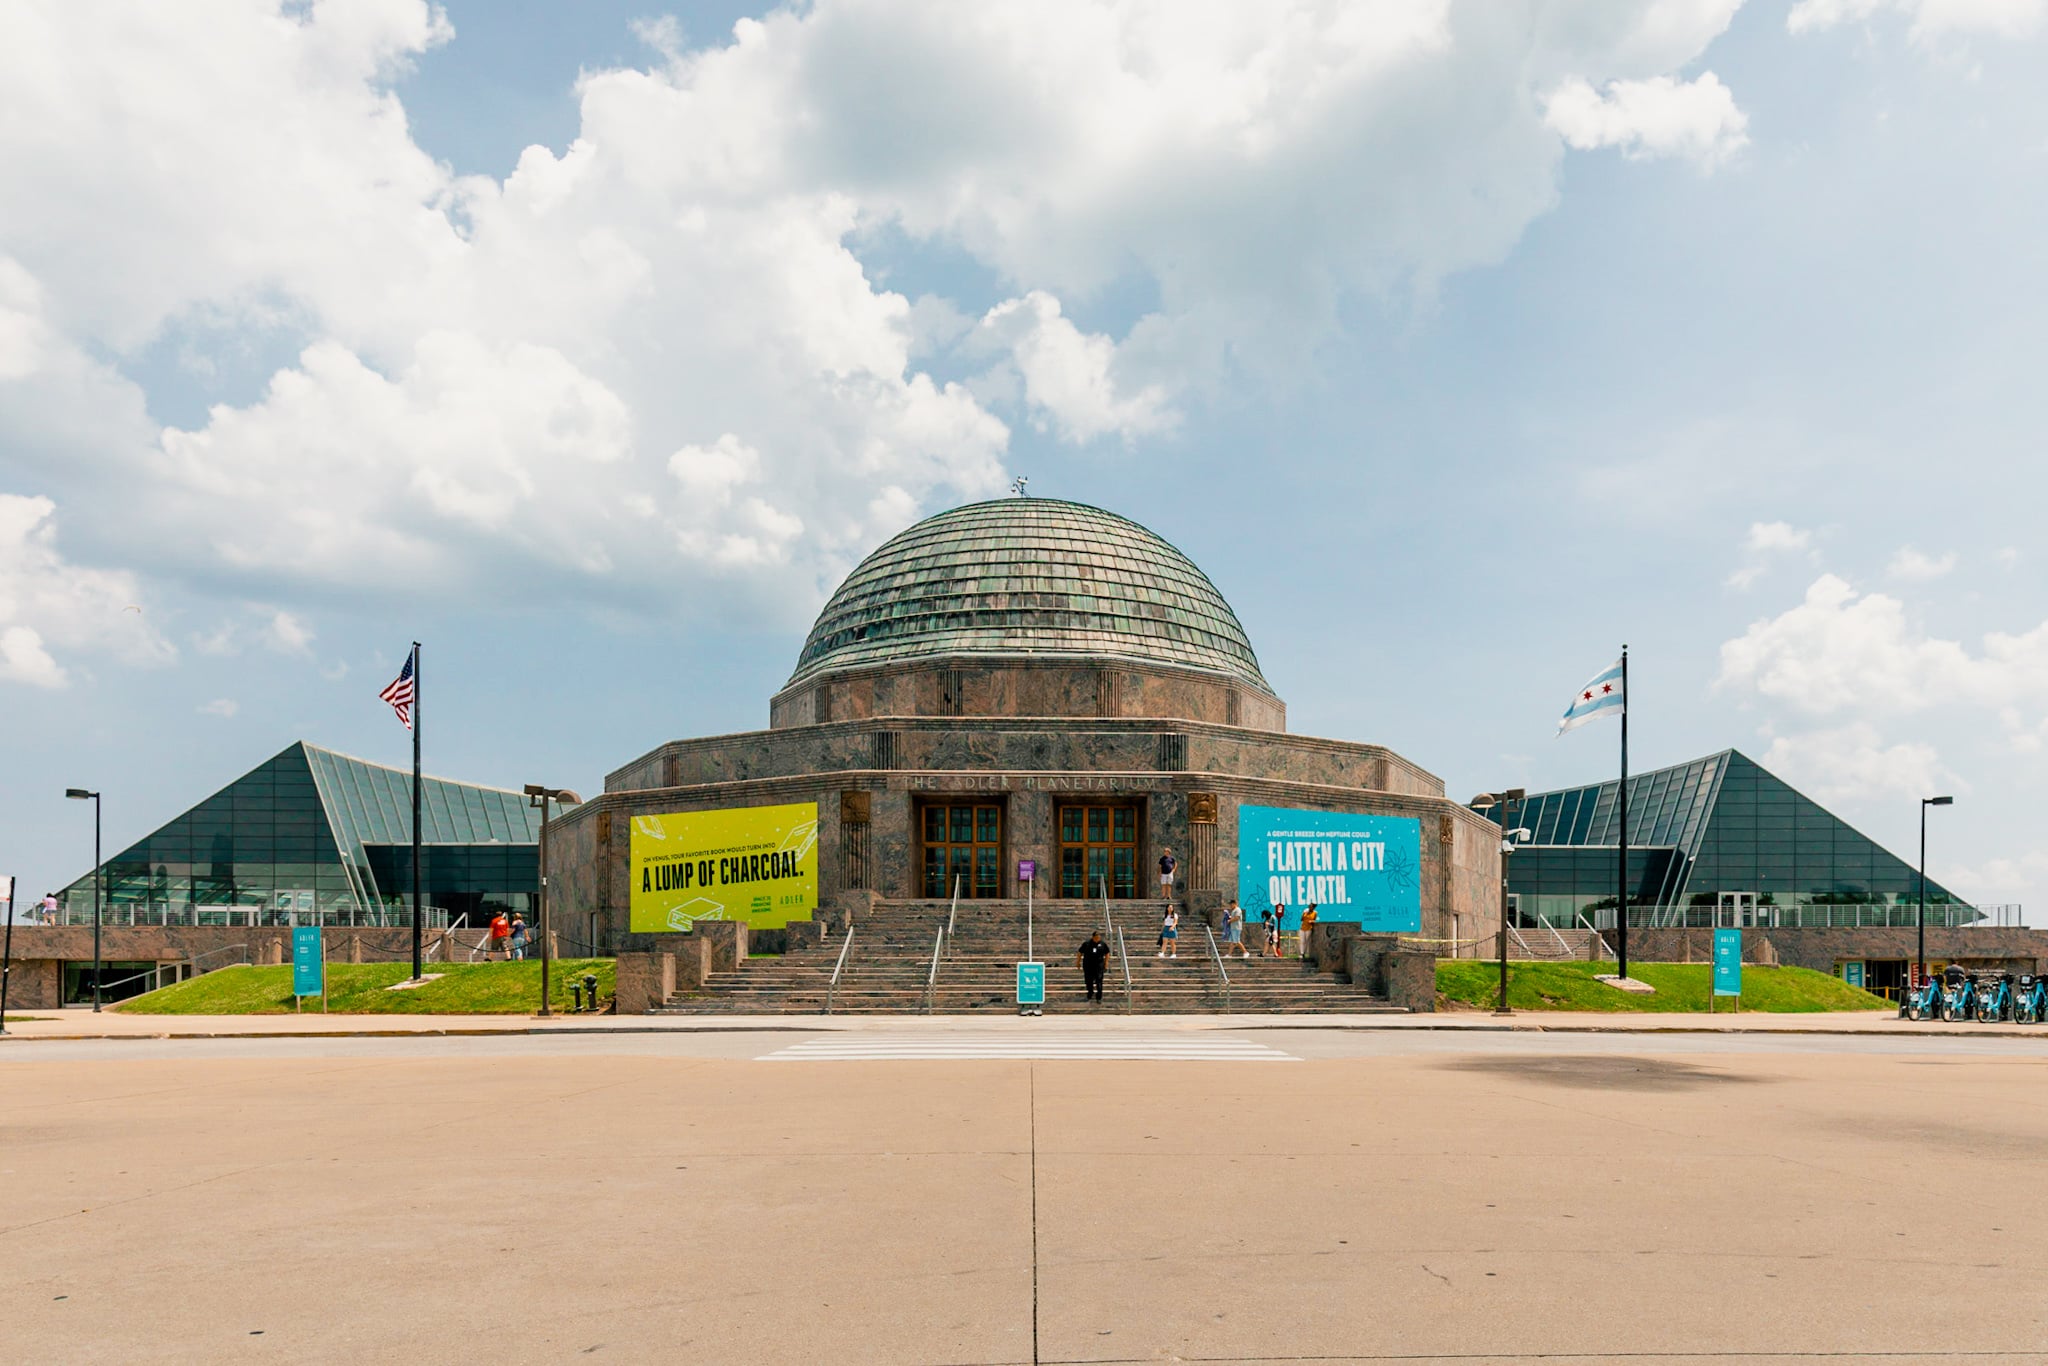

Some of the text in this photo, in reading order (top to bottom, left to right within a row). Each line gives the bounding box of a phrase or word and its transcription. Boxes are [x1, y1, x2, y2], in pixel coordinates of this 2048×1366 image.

[903, 775, 1157, 790] THE ADLER PLANETARIUM
[1272, 830, 1293, 838] GENTLE
[686, 850, 709, 858] FAVORITE
[1268, 841, 1385, 872] FLATTEN A CITY
[642, 850, 804, 893] A LUMP OF CHARCOAL.
[1269, 875, 1352, 906] ON EARTH.
[780, 894, 803, 905] ADLER
